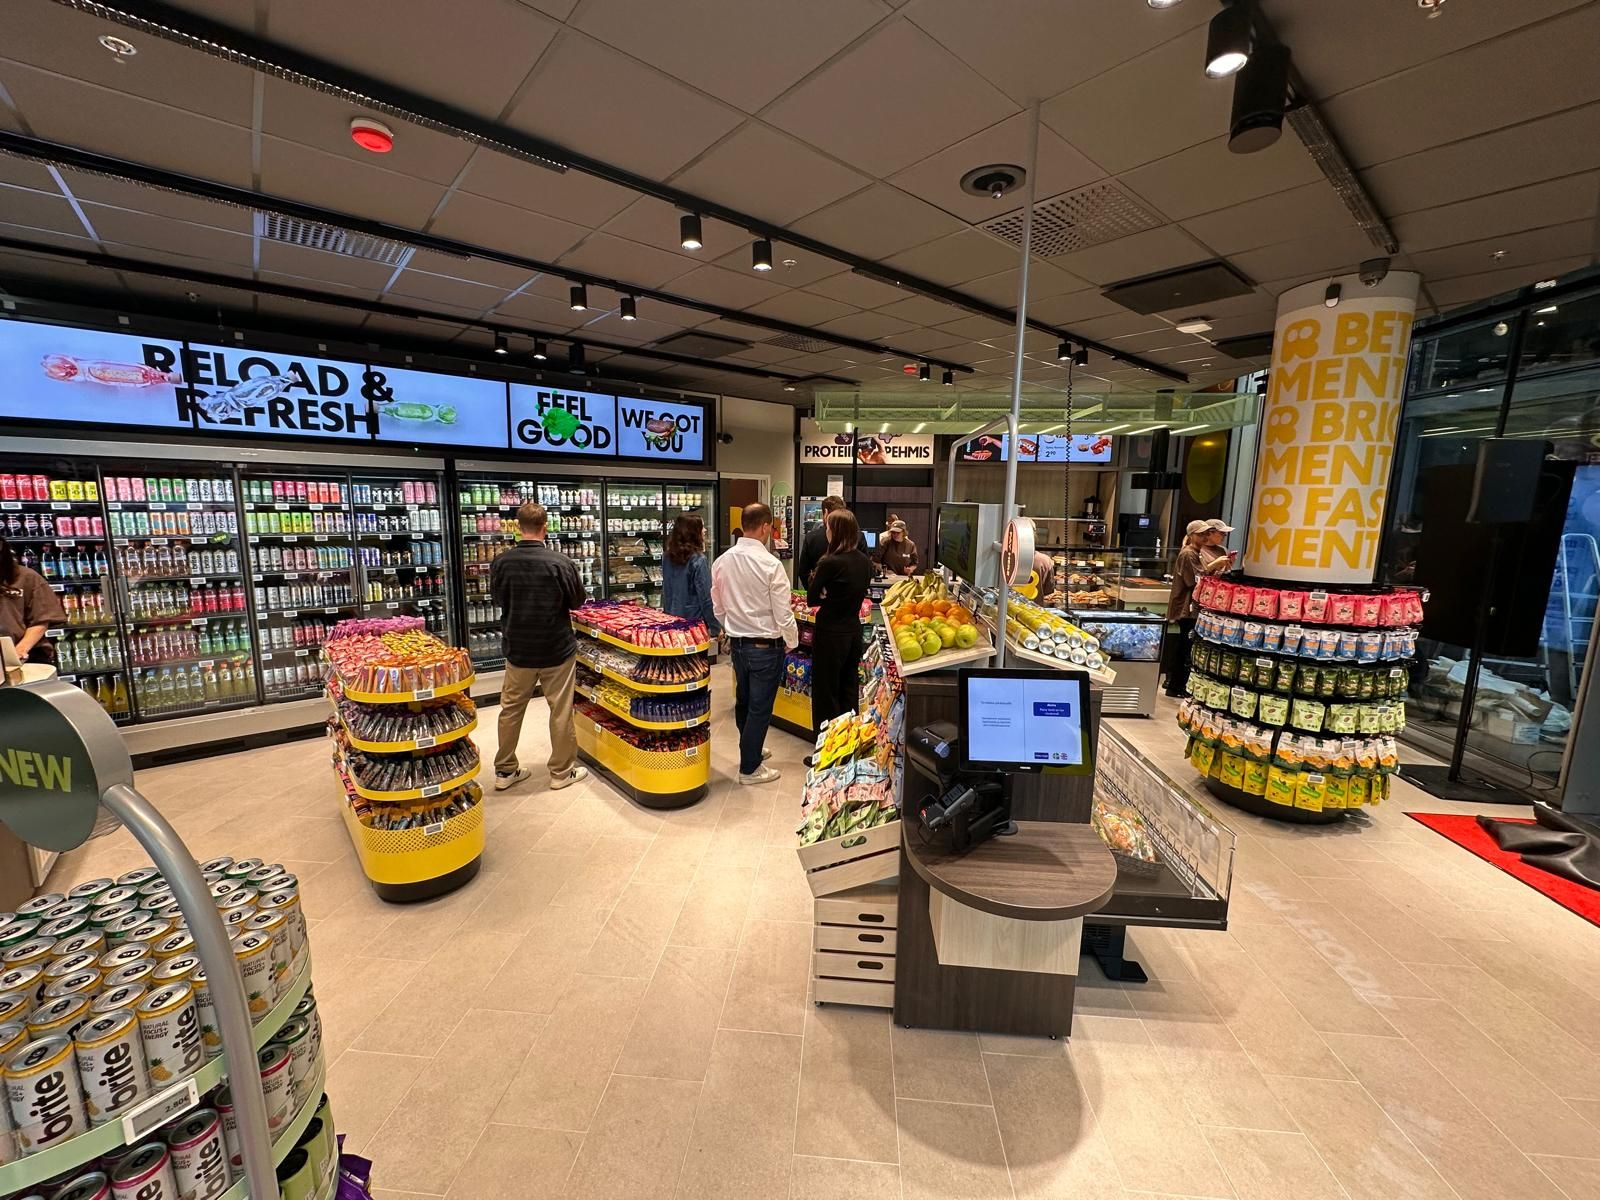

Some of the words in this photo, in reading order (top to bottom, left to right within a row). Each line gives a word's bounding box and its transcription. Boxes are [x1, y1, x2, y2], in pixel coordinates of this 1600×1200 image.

[142, 344, 349, 397] RELOAD
[362, 370, 393, 402] &
[537, 392, 592, 421] FEEL
[641, 431, 684, 453] YOU
[885, 445, 930, 458] PEHMIS
[0, 749, 71, 793] NEW
[172, 1005, 201, 1074] brite
[99, 1042, 138, 1113] brite
[30, 1070, 73, 1145] brite
[195, 1137, 226, 1200] brite
